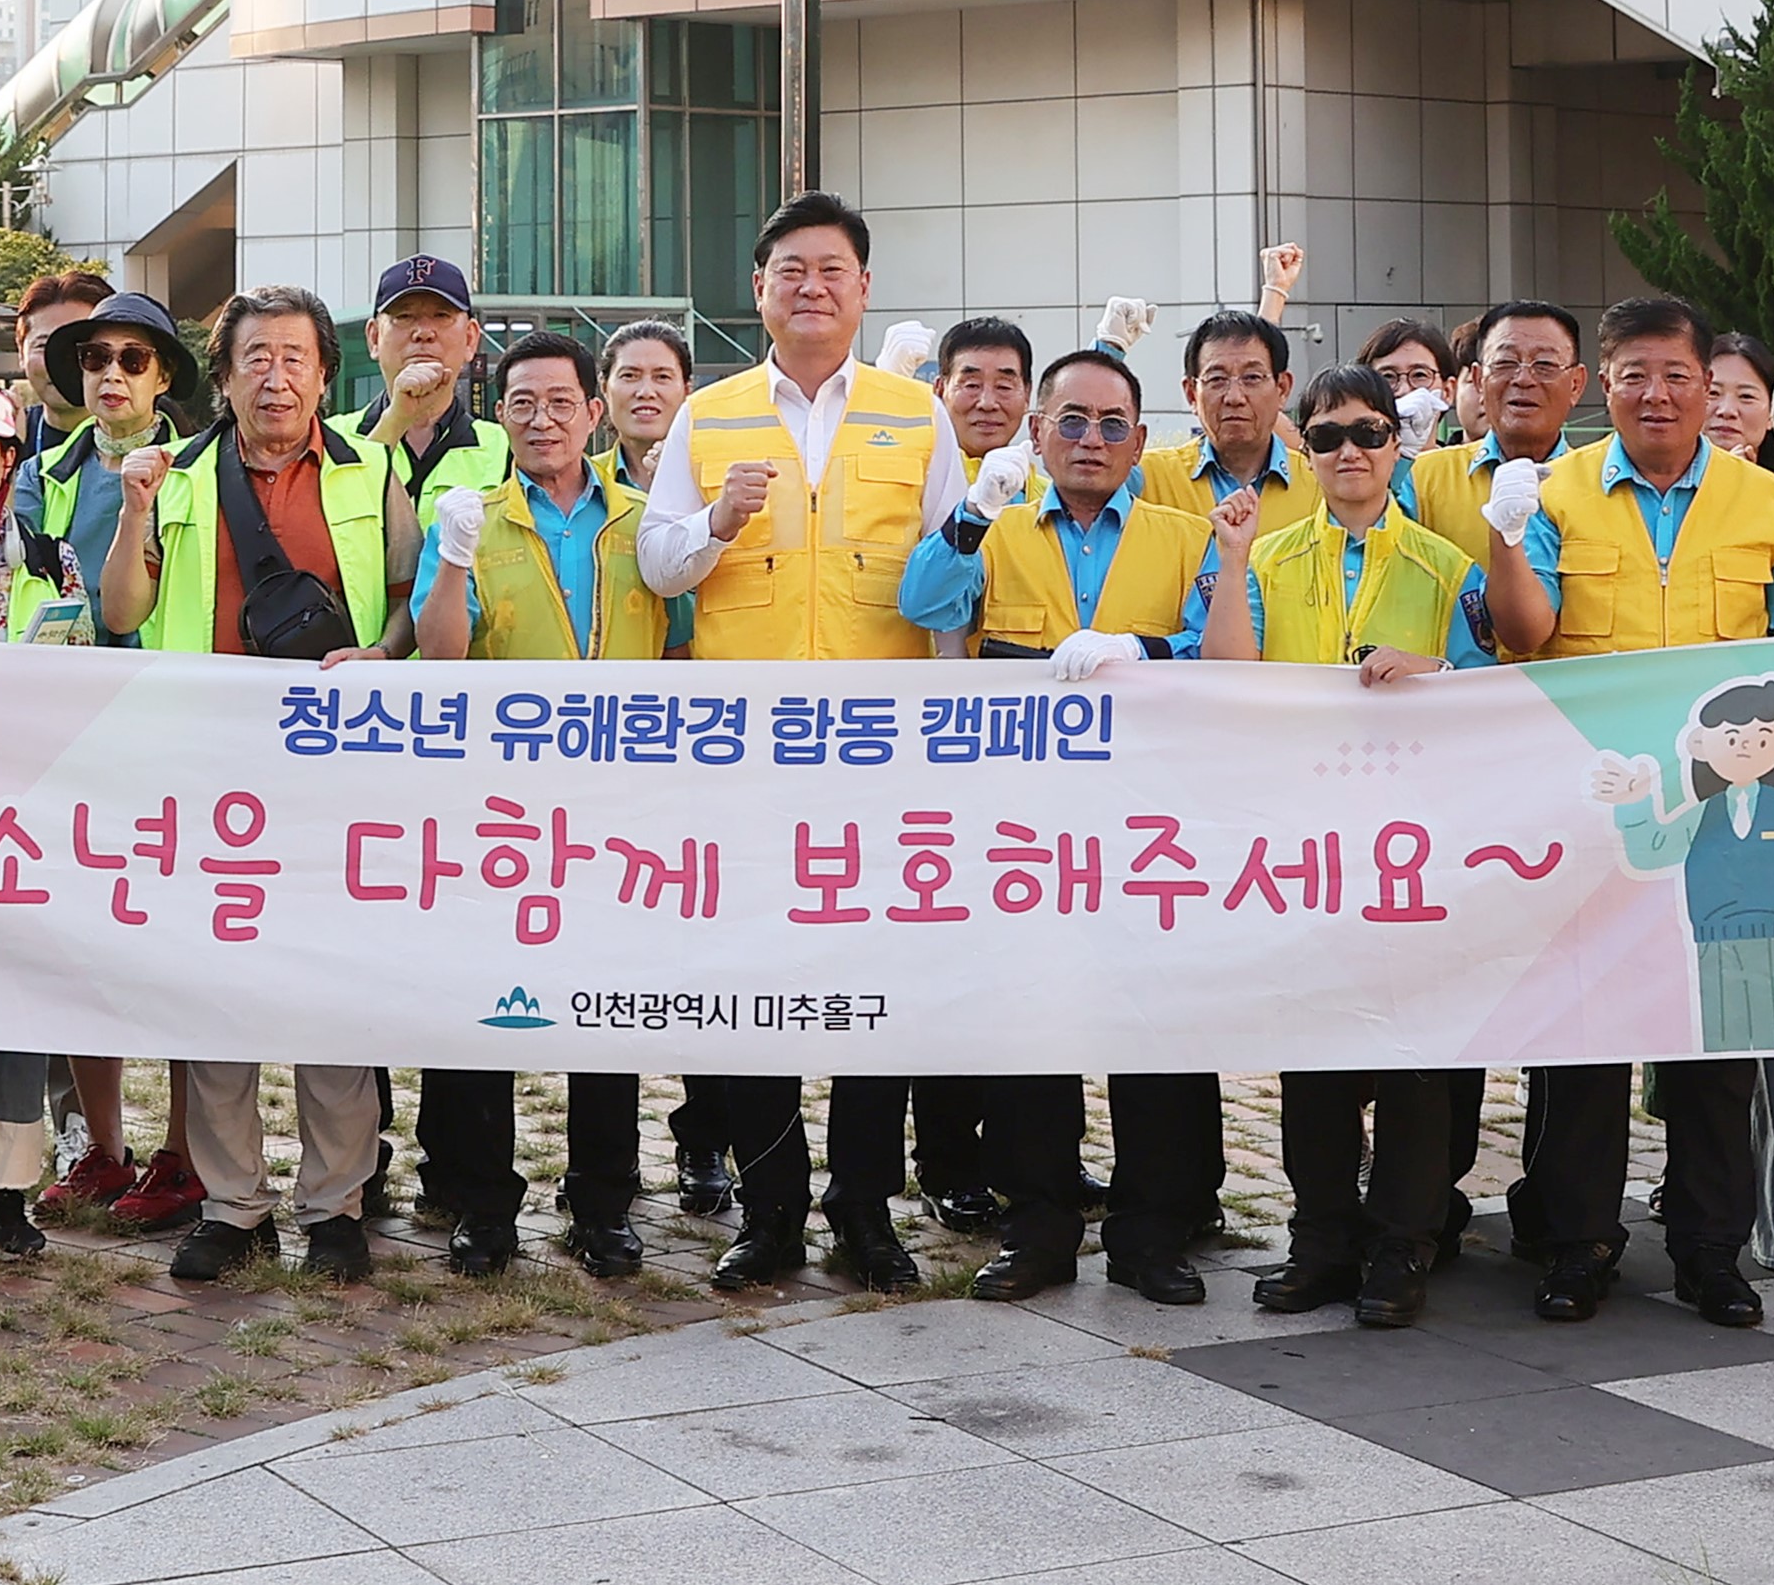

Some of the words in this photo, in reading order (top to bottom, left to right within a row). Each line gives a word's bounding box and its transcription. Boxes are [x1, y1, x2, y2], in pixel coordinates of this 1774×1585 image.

[407, 259, 436, 285] F
[279, 684, 470, 762] 청소년
[491, 692, 747, 766] 유해환경
[771, 695, 899, 766] 합동
[919, 692, 1112, 764] 캠페인
[345, 794, 721, 945] 다함께
[786, 809, 1564, 931] 보호해주세요~
[570, 990, 739, 1031] 인천광역시
[753, 991, 889, 1033] 미추홀구
